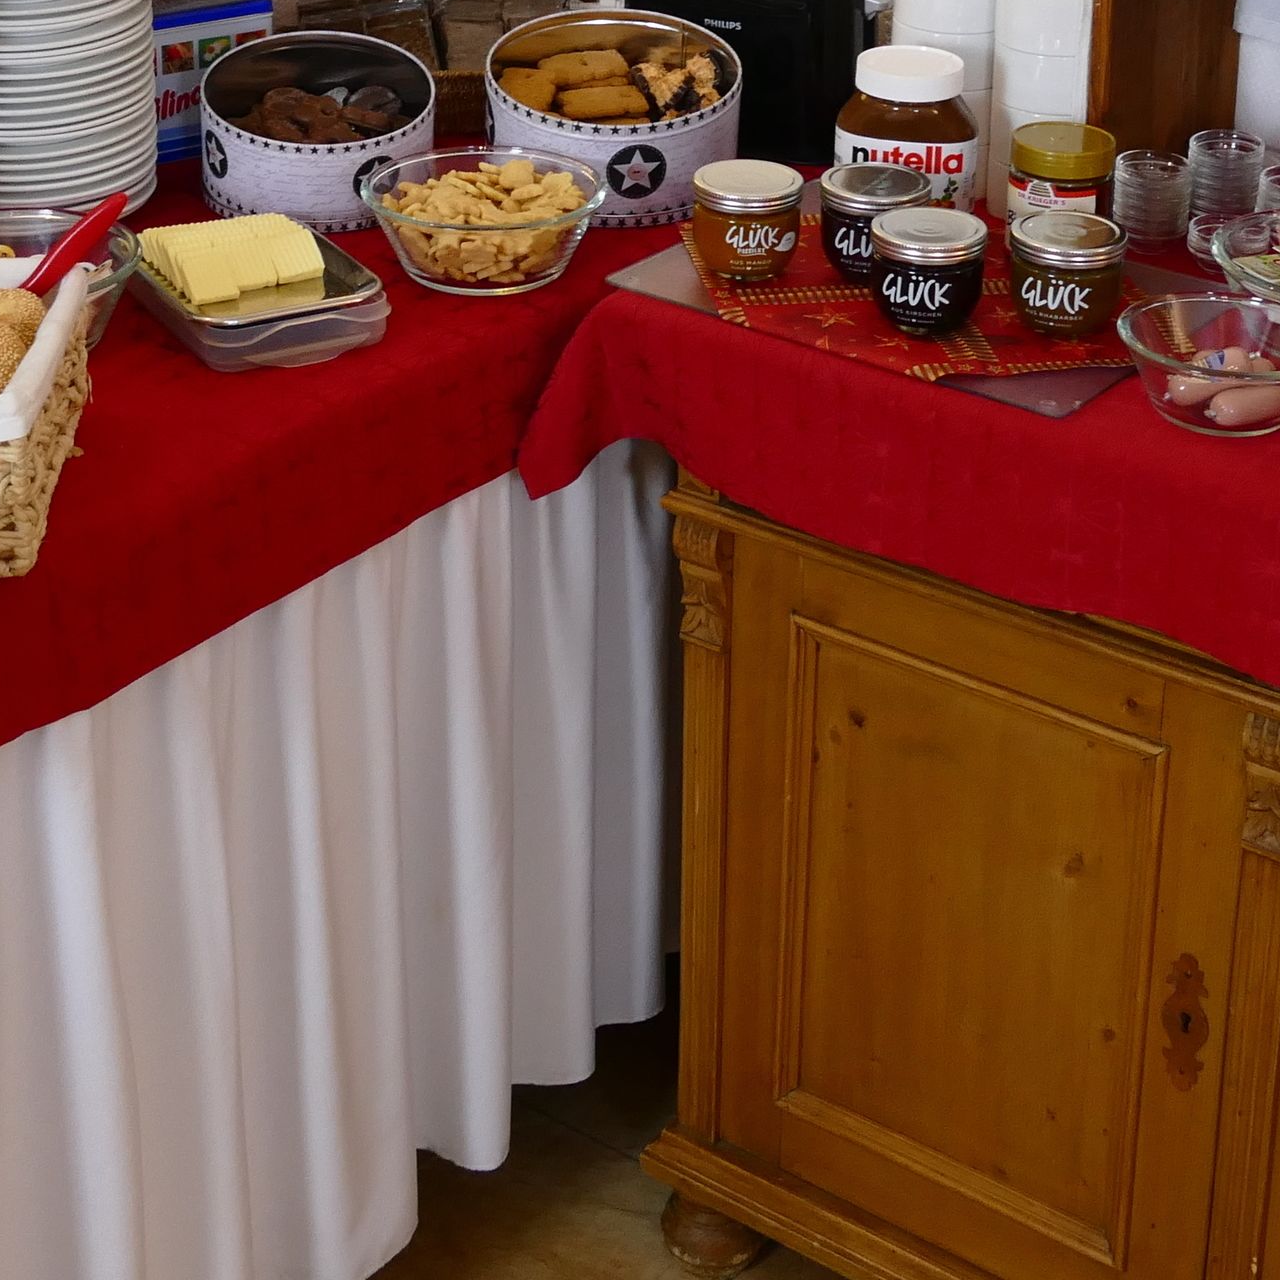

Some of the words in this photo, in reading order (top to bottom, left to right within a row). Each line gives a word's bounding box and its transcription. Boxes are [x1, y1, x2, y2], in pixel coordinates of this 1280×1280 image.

[704, 18, 742, 31] PHILIPS
[851, 146, 964, 175] nutella
[725, 223, 780, 250] GLÜCK
[834, 226, 873, 258] GLÜ
[882, 273, 953, 311] GLÜCK
[1021, 276, 1093, 315] GLÜCK
